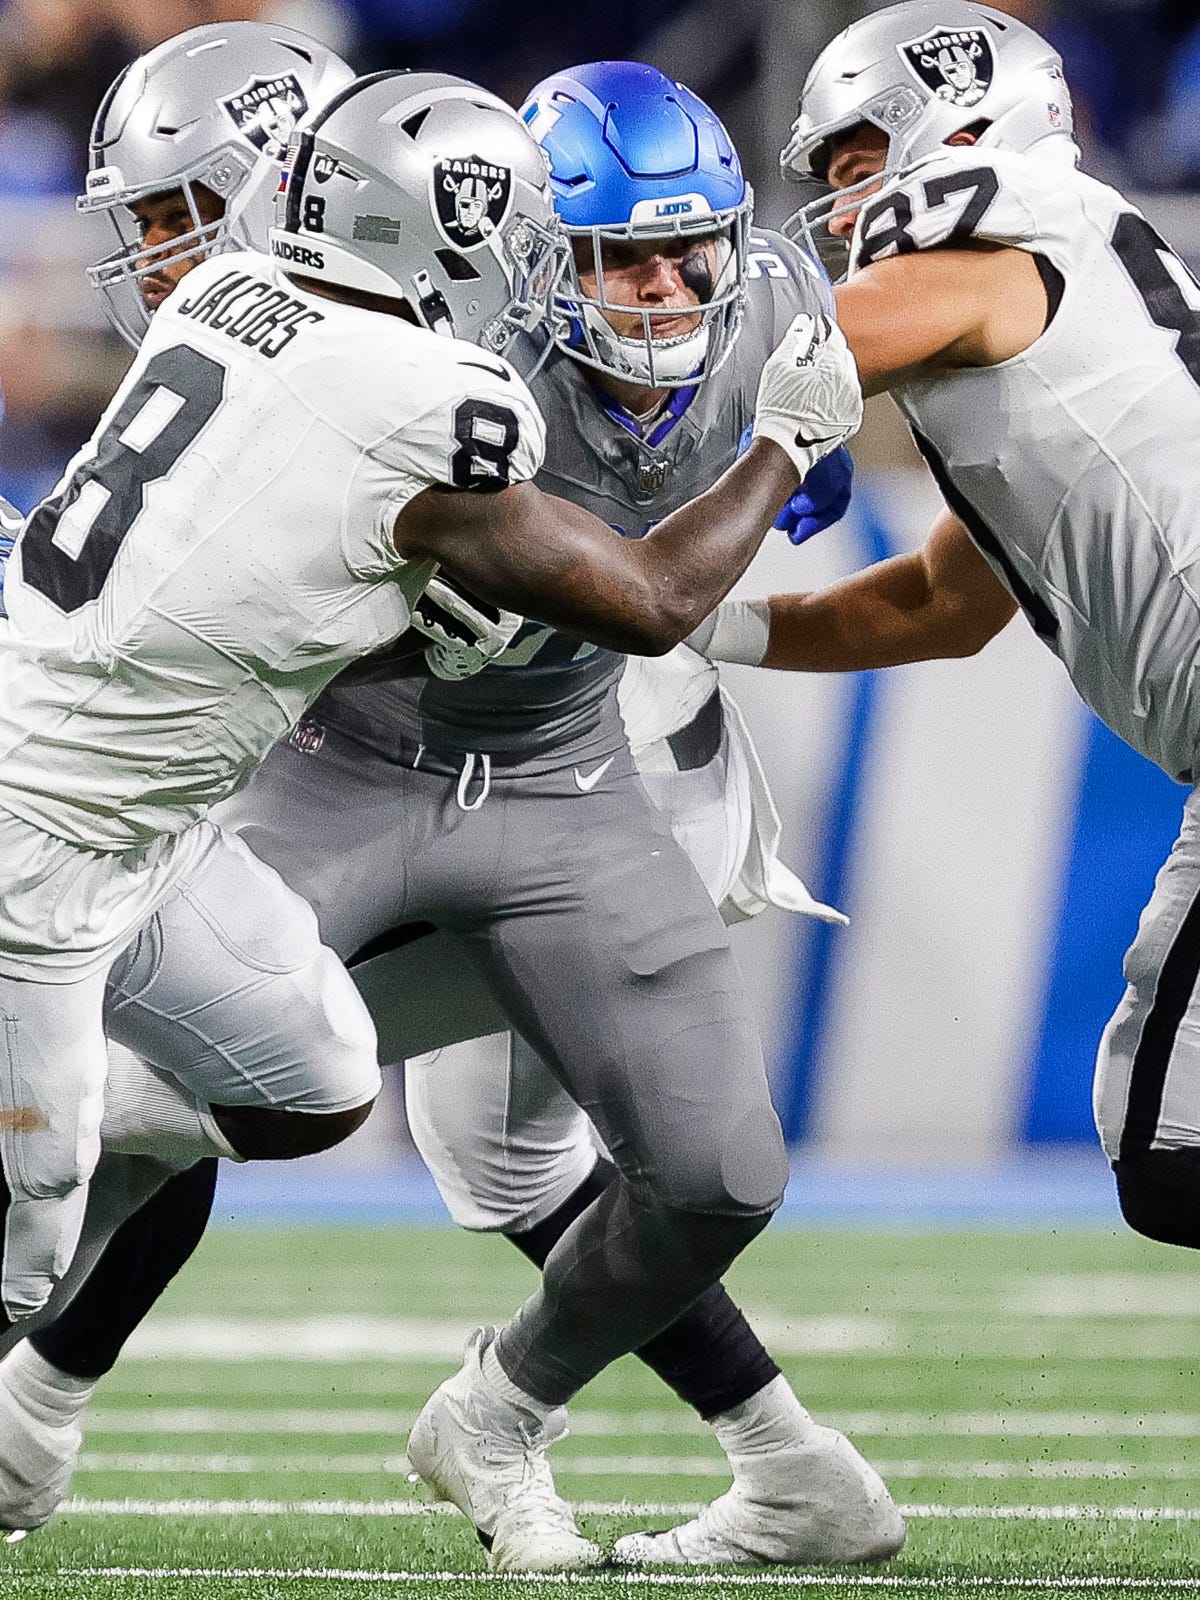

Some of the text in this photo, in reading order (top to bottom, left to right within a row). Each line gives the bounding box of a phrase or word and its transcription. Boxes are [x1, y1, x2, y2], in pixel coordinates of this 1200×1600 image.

[911, 31, 980, 55] RAIDERS
[230, 76, 295, 111] RAIDERS
[441, 159, 507, 181] RAIDERS
[303, 194, 327, 234] 8
[856, 166, 999, 269] 87
[177, 270, 326, 359] JACOBS
[449, 396, 520, 492] 8
[18, 341, 228, 616] 8
